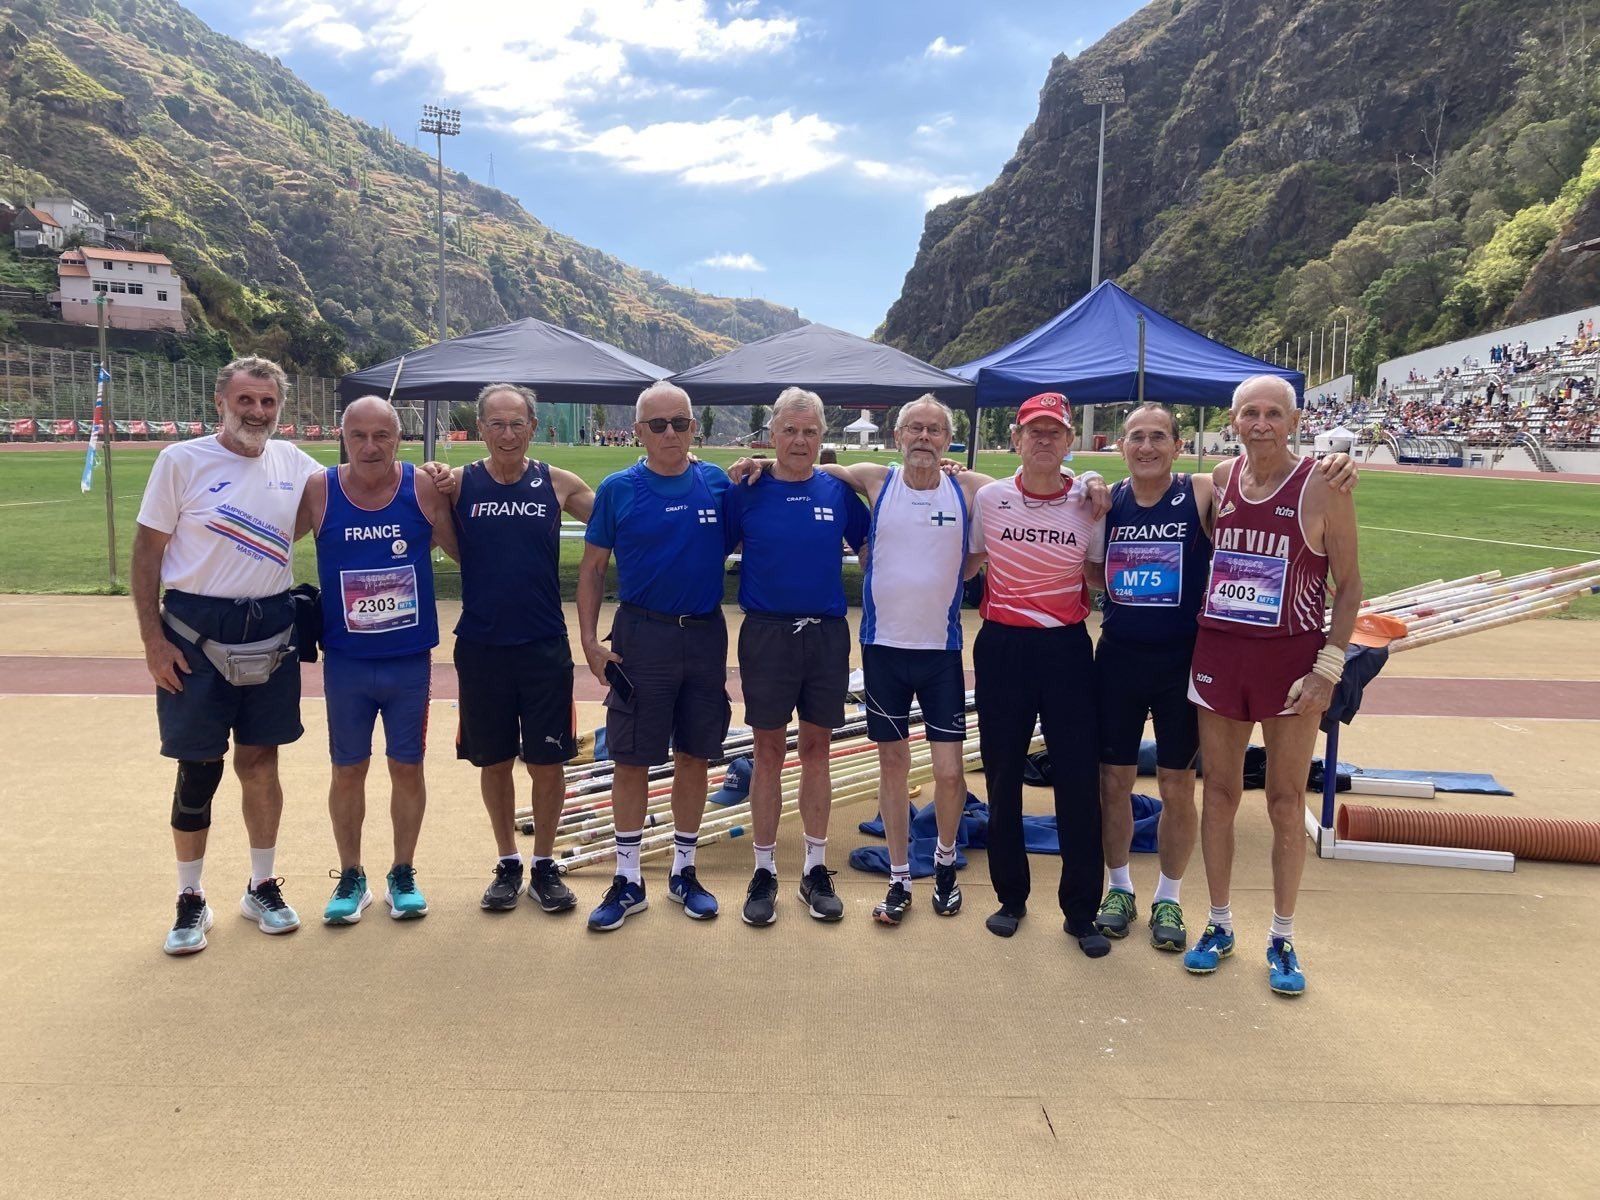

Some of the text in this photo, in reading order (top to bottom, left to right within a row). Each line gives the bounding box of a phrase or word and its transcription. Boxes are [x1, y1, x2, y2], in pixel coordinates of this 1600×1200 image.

[477, 501, 547, 518] FRANCE
[252, 517, 280, 536] ITALIANO
[344, 524, 402, 541] FRANCE
[1115, 522, 1188, 541] FRANCE
[1000, 527, 1077, 547] AUSTRIA
[1214, 527, 1291, 558] LATVIJA
[235, 543, 264, 561] MASTER
[1123, 570, 1162, 587] M75
[1114, 588, 1134, 597] 2246
[1218, 583, 1256, 602] 4003
[1258, 595, 1275, 604] M75
[357, 597, 396, 613] 2303
